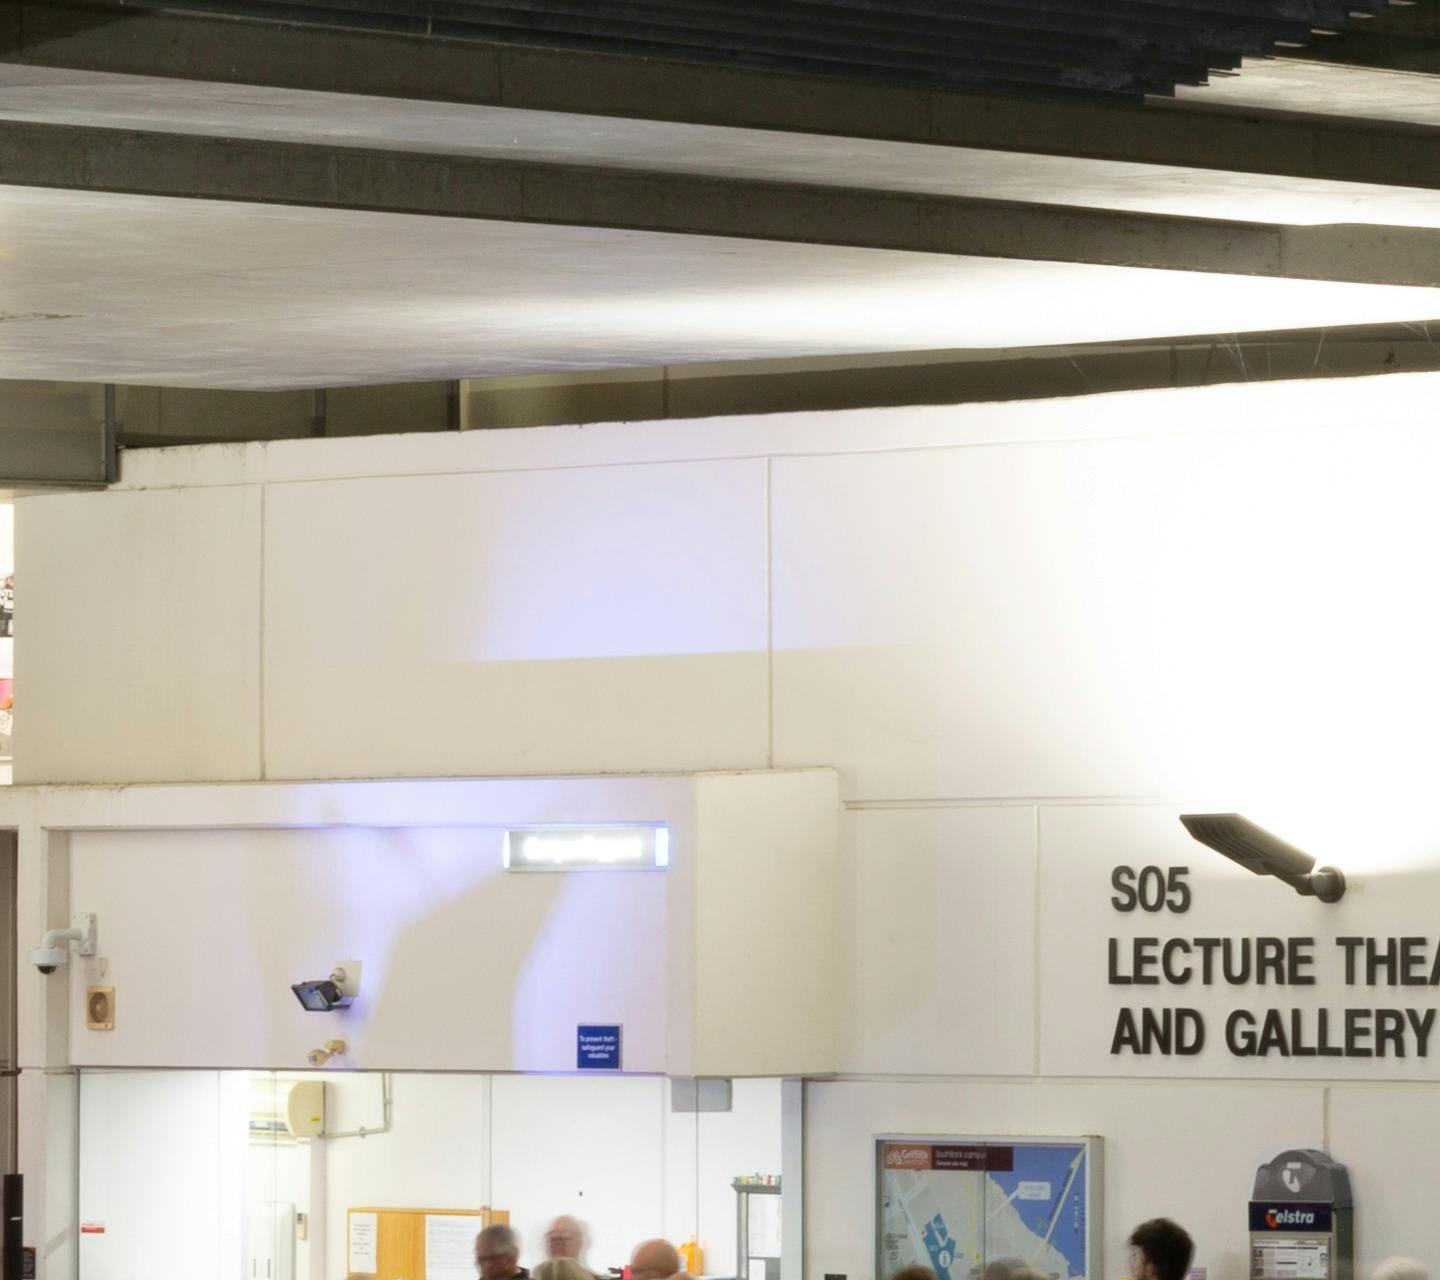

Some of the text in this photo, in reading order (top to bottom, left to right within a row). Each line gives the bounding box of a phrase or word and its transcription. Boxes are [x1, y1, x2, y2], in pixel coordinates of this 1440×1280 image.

[1107, 937, 1317, 986] LECTURE
[1109, 1007, 1438, 1058] AND GALLERY
[1264, 1208, 1316, 1230] Telstra
